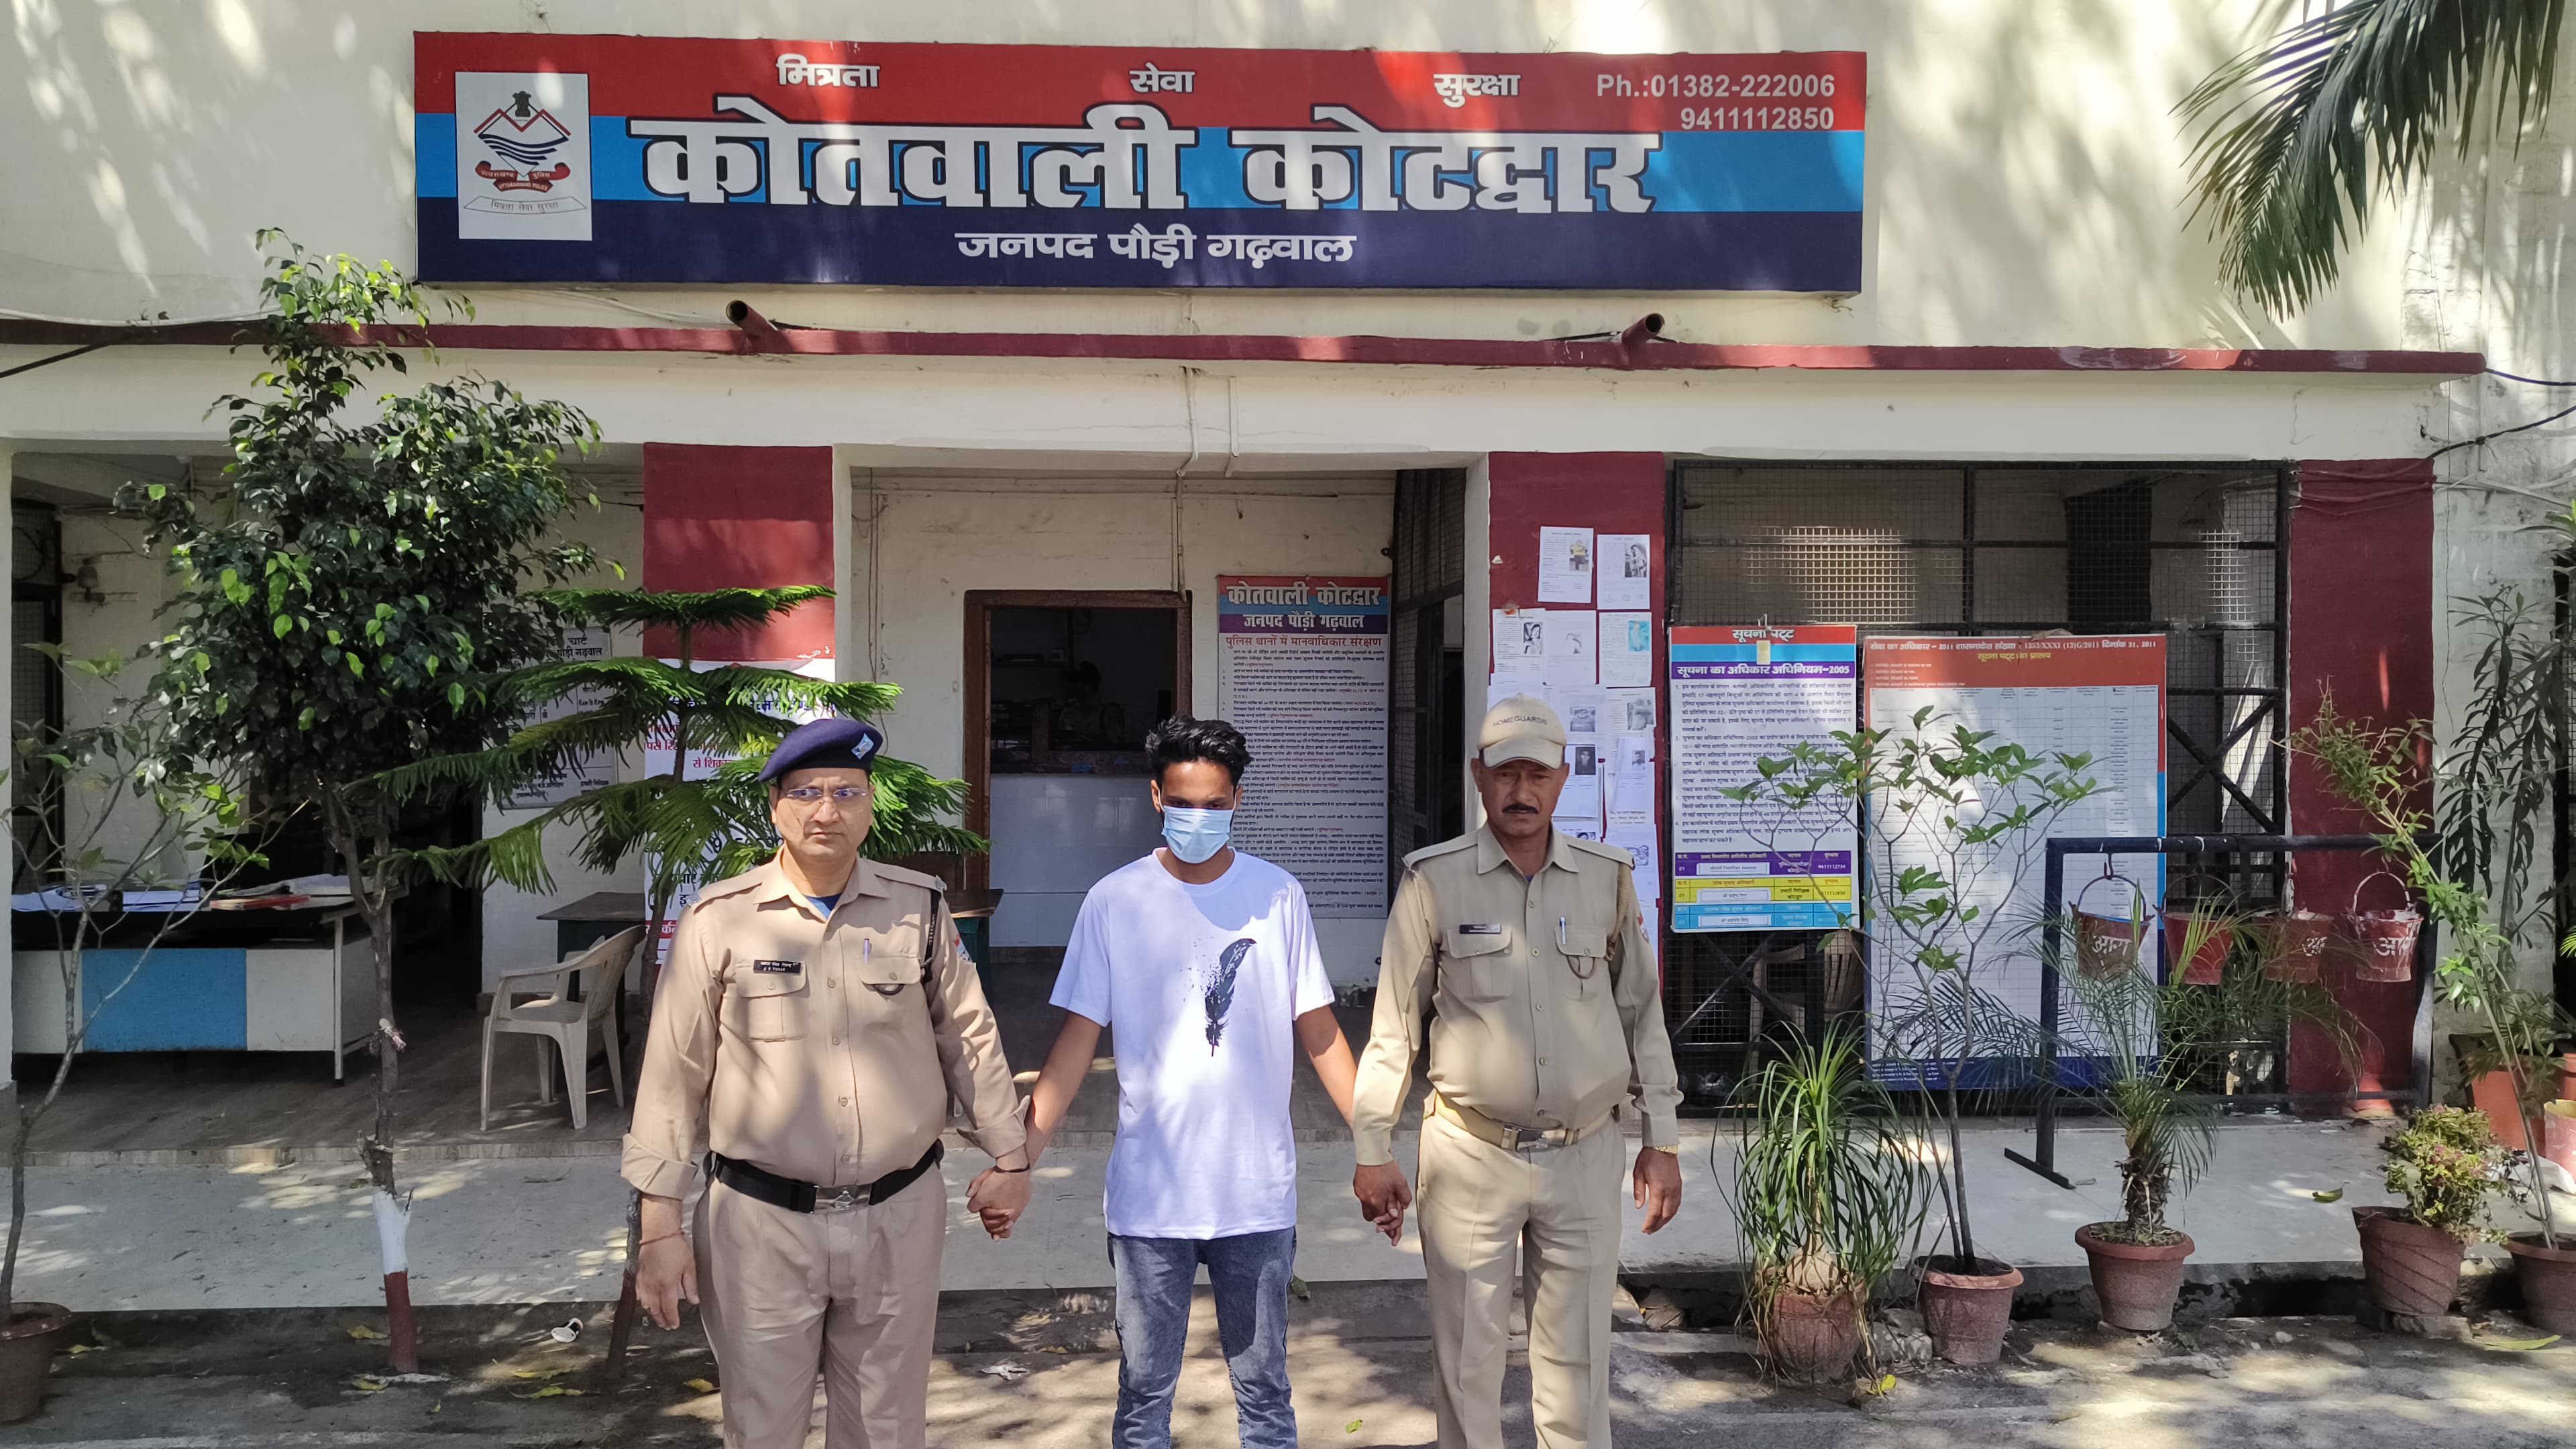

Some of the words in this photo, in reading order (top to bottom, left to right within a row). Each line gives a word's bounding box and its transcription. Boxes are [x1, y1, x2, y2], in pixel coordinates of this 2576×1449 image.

[777, 53, 880, 88] मित्रता
[1129, 62, 1195, 93] सेवा
[1434, 73, 1521, 107] सुरक्षा
[1680, 107, 1834, 130] 9411112850
[629, 95, 1197, 209] कोतवाली
[1230, 105, 1661, 213] कोटद्वार
[955, 232, 1098, 259] जनपद
[1108, 222, 1196, 268] पौड़ी
[1207, 235, 1357, 268] गढ़वाल
[1226, 581, 1309, 605] कोतवाली
[1316, 582, 1381, 606] कोटद्वार
[1243, 614, 1283, 627] जनपद
[1288, 611, 1316, 631] पौड़ी
[1320, 615, 1364, 631] गढ़वाल
[1226, 635, 1252, 649] पुलिस
[1733, 629, 1766, 643] सूचना
[1676, 665, 1708, 678] सूचना
[1710, 665, 1725, 674] का
[1727, 664, 1770, 674] अधिकार
